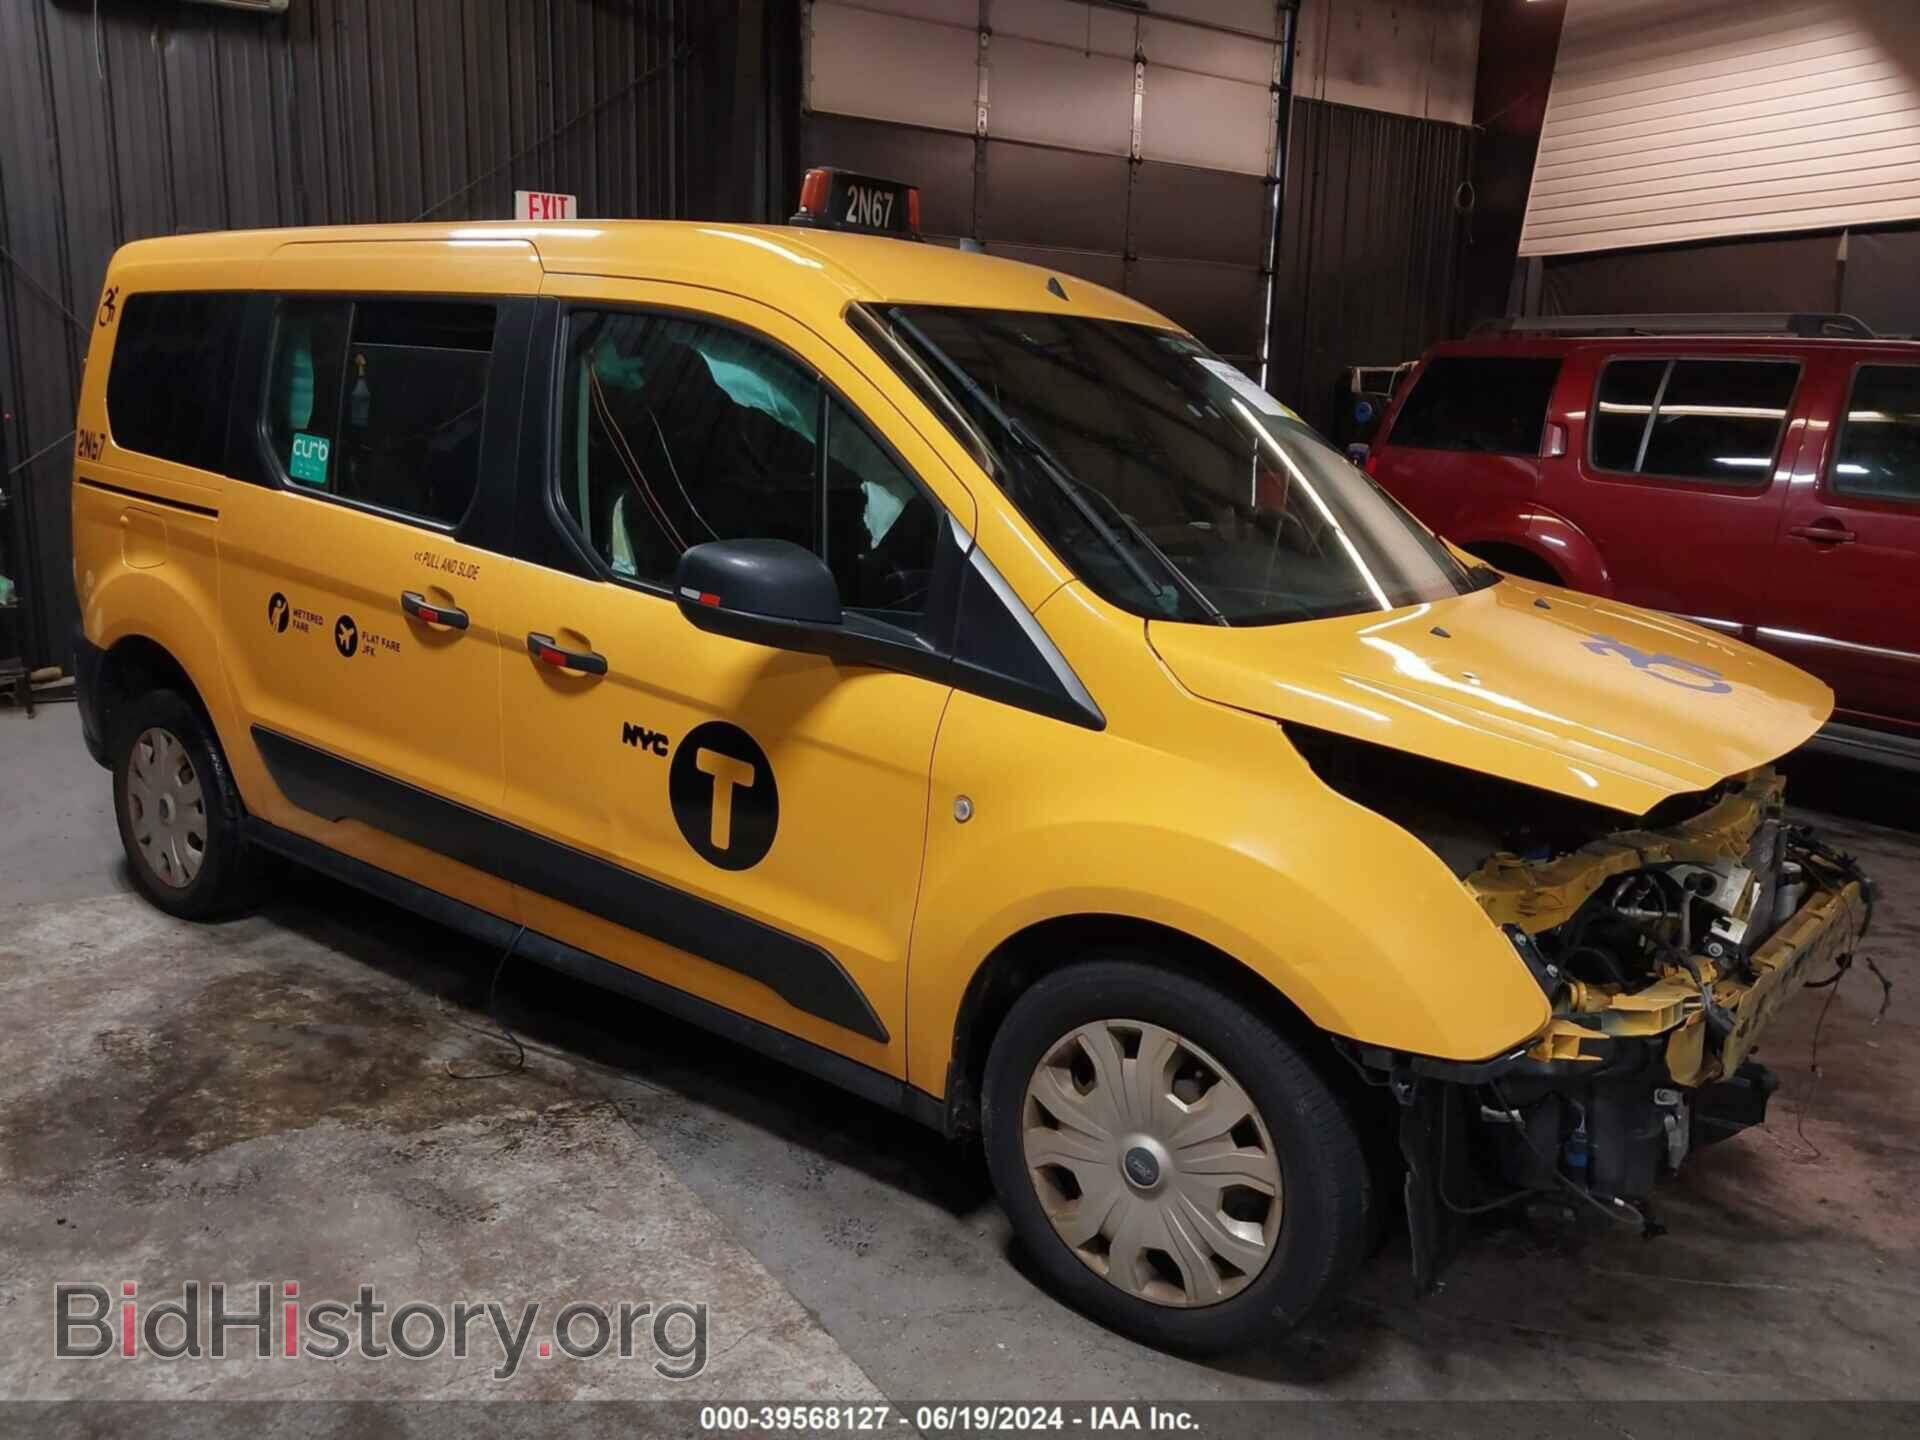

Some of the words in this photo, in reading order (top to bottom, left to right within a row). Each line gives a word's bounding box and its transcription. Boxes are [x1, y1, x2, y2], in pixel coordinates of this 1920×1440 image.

[528, 193, 568, 219] EXIT
[846, 184, 894, 229] 2N67
[293, 438, 329, 462] curb
[421, 551, 442, 569] PULL
[440, 557, 458, 574] AND
[457, 561, 480, 580] SLIDE
[292, 607, 324, 626] METERED
[292, 619, 309, 633] FARE
[361, 631, 380, 645] FLAT
[381, 639, 401, 653] FARE
[361, 645, 376, 656] JFK
[622, 721, 669, 757] NYC
[696, 747, 755, 850] T
